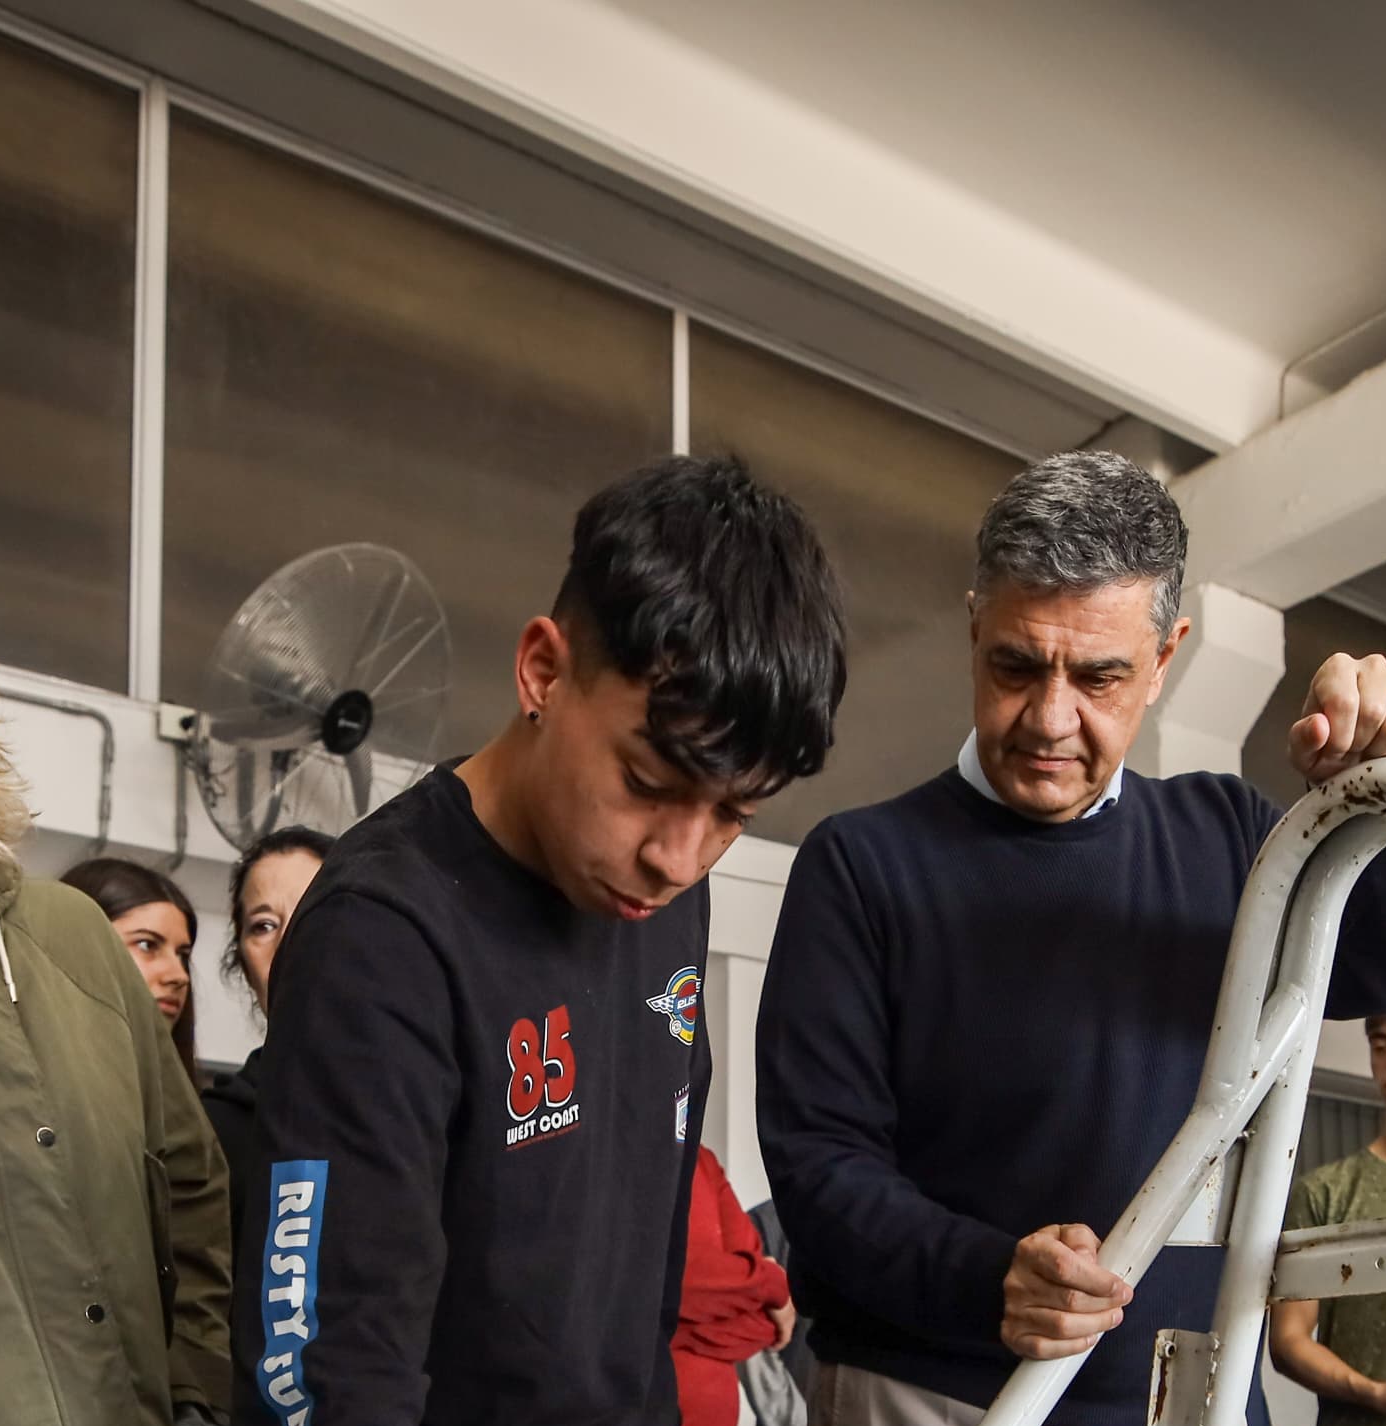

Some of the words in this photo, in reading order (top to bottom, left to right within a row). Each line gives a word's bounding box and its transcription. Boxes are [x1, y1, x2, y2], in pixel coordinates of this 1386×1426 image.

[506, 1004, 576, 1122] 85
[506, 1118, 537, 1145] WEST
[539, 1103, 581, 1133] COAST
[268, 1181, 315, 1340] RUSTY
